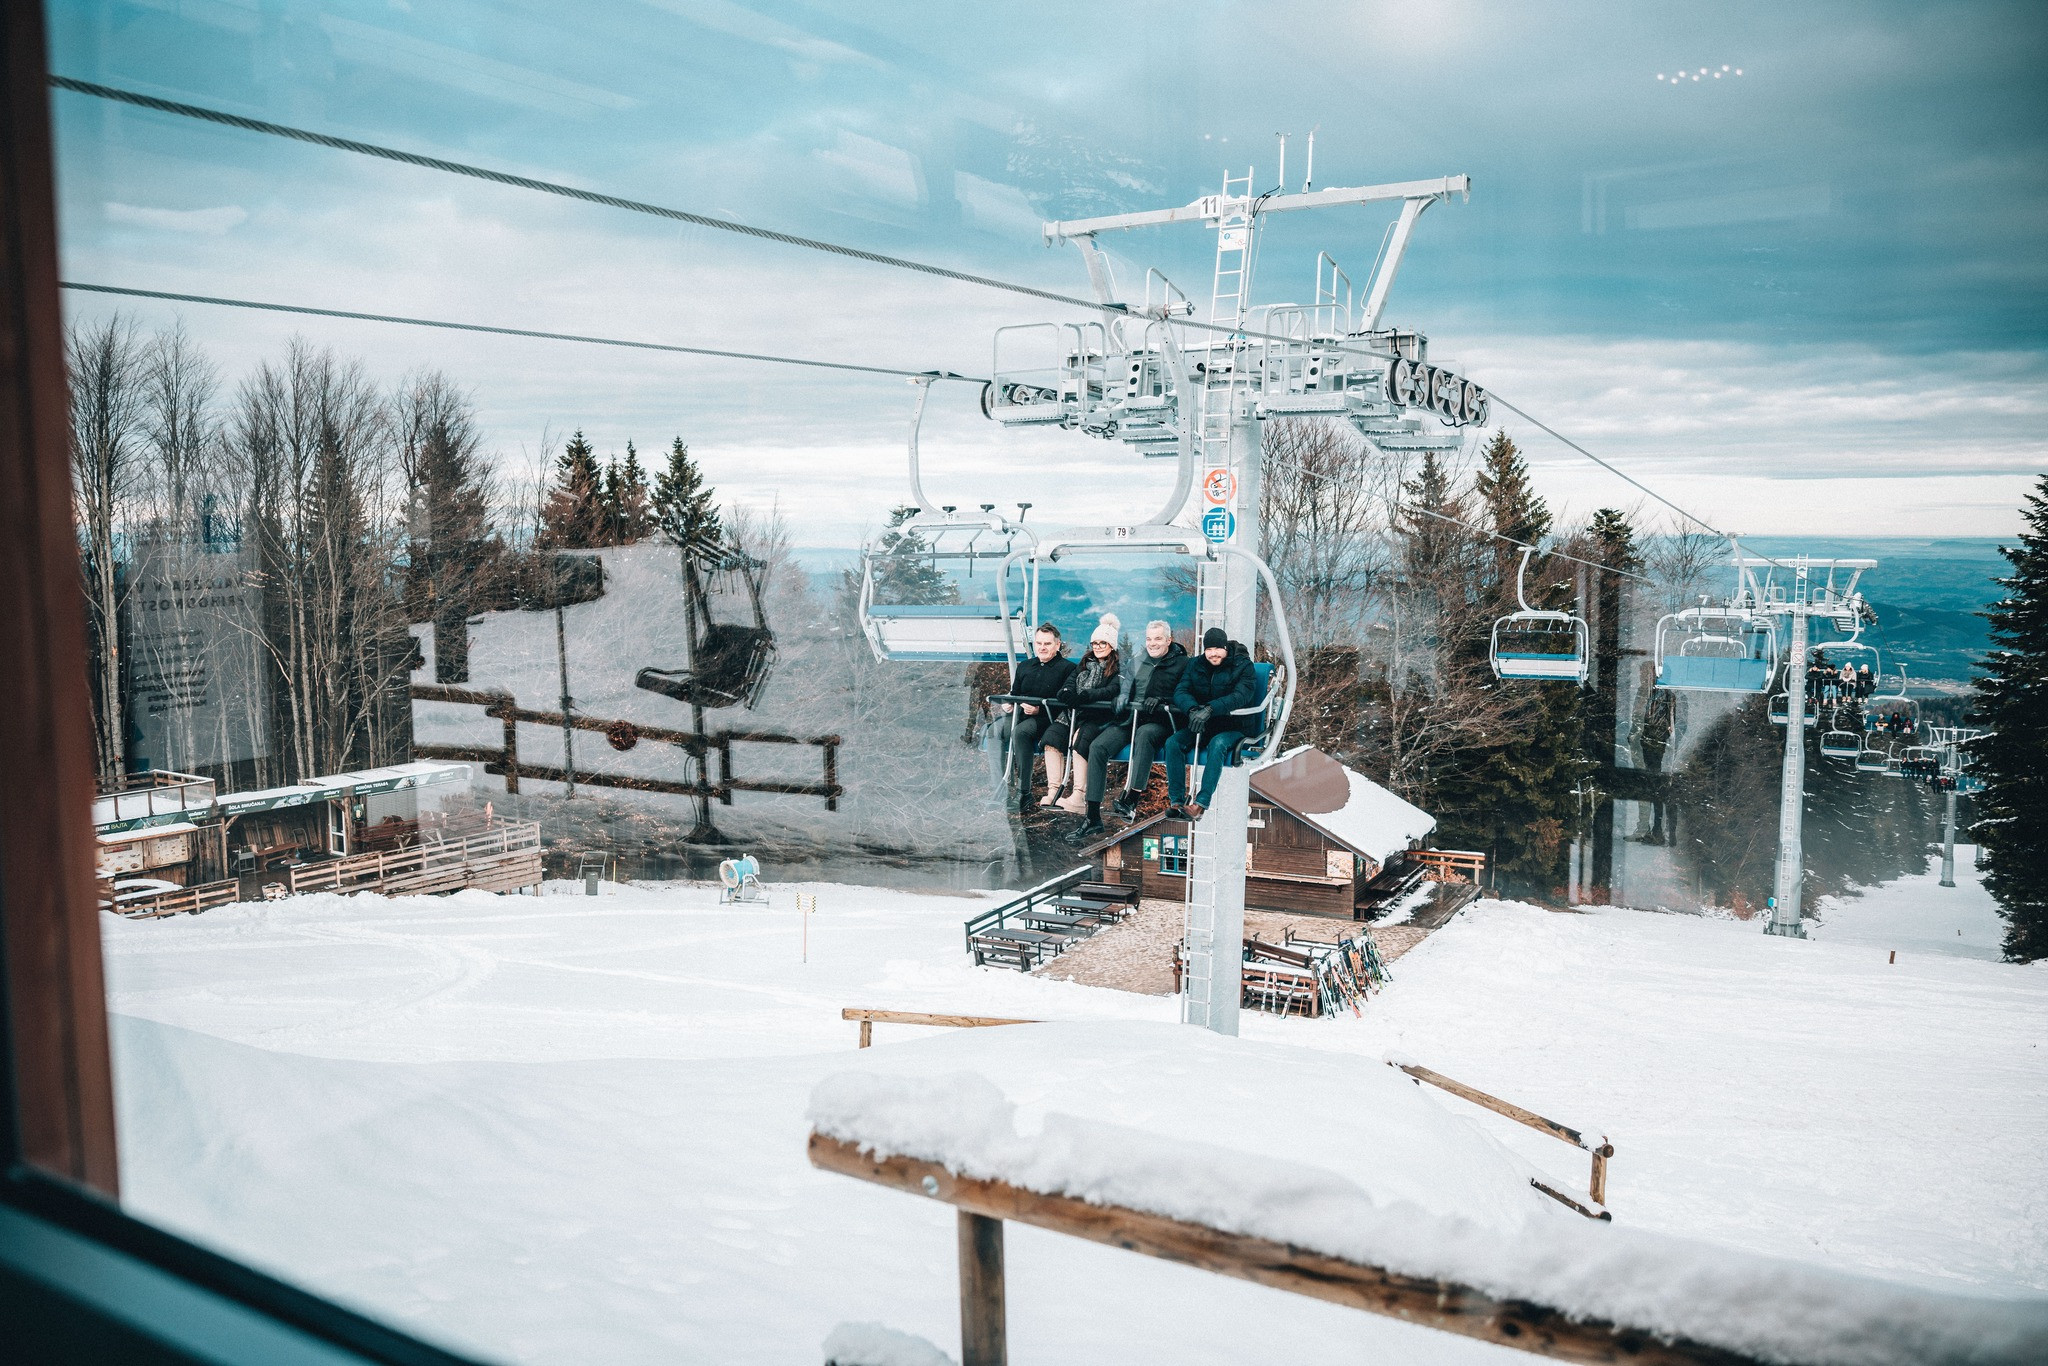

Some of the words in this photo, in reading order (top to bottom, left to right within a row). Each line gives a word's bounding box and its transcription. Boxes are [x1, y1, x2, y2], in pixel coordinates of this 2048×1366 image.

[1202, 197, 1217, 214] 11
[1117, 527, 1127, 537] 79
[111, 822, 128, 830] BAJTA
